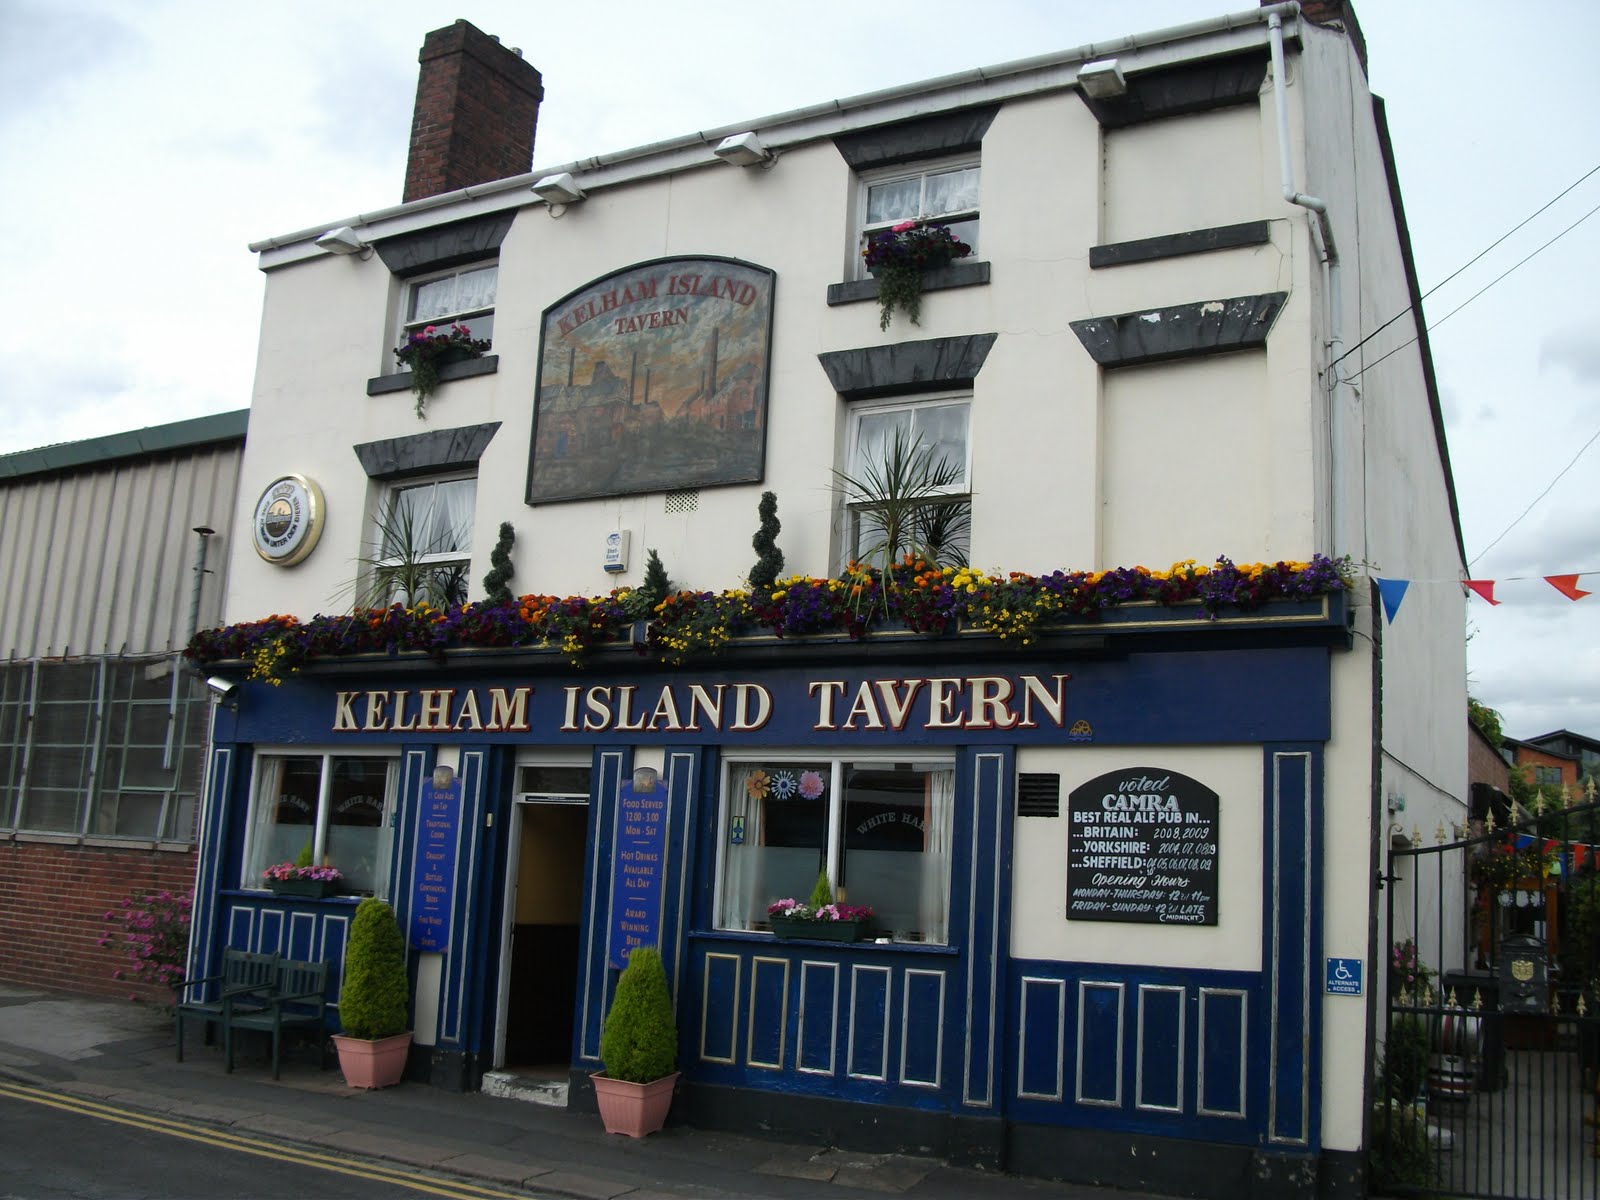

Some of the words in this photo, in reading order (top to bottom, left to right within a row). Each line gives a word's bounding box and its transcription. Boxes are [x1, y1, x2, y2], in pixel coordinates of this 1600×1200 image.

[556, 278, 657, 338] KELHAM
[666, 274, 758, 306] ISLAND
[615, 307, 690, 335] TAVERN
[332, 686, 534, 733] KELHAM
[560, 683, 774, 732] ISLAND
[808, 673, 1071, 731] TAVERN
[1119, 775, 1170, 792] voted
[366, 795, 385, 812] HAR
[623, 798, 640, 808] FOOD
[641, 799, 663, 809] SERVED
[1102, 793, 1180, 812] CAMRA
[856, 812, 896, 834] WHITE
[901, 813, 926, 833] HAR
[1073, 811, 1101, 823] BEST
[1103, 811, 1131, 823] REAL
[1133, 812, 1155, 823] ALE
[1157, 812, 1182, 824] PUB
[625, 825, 641, 835] MON
[646, 826, 657, 836] SAT
[621, 850, 634, 860] HOT
[635, 851, 658, 861] DRINKS
[624, 864, 654, 875] AVAILABLE
[625, 878, 636, 888] ALL
[637, 878, 650, 889] DAY
[1092, 873, 1147, 888] Opening
[1151, 874, 1190, 888] Hours
[625, 908, 646, 919] AWARD
[1180, 904, 1205, 915] LATE
[620, 921, 649, 933] WINNING
[626, 935, 641, 946] BEER
